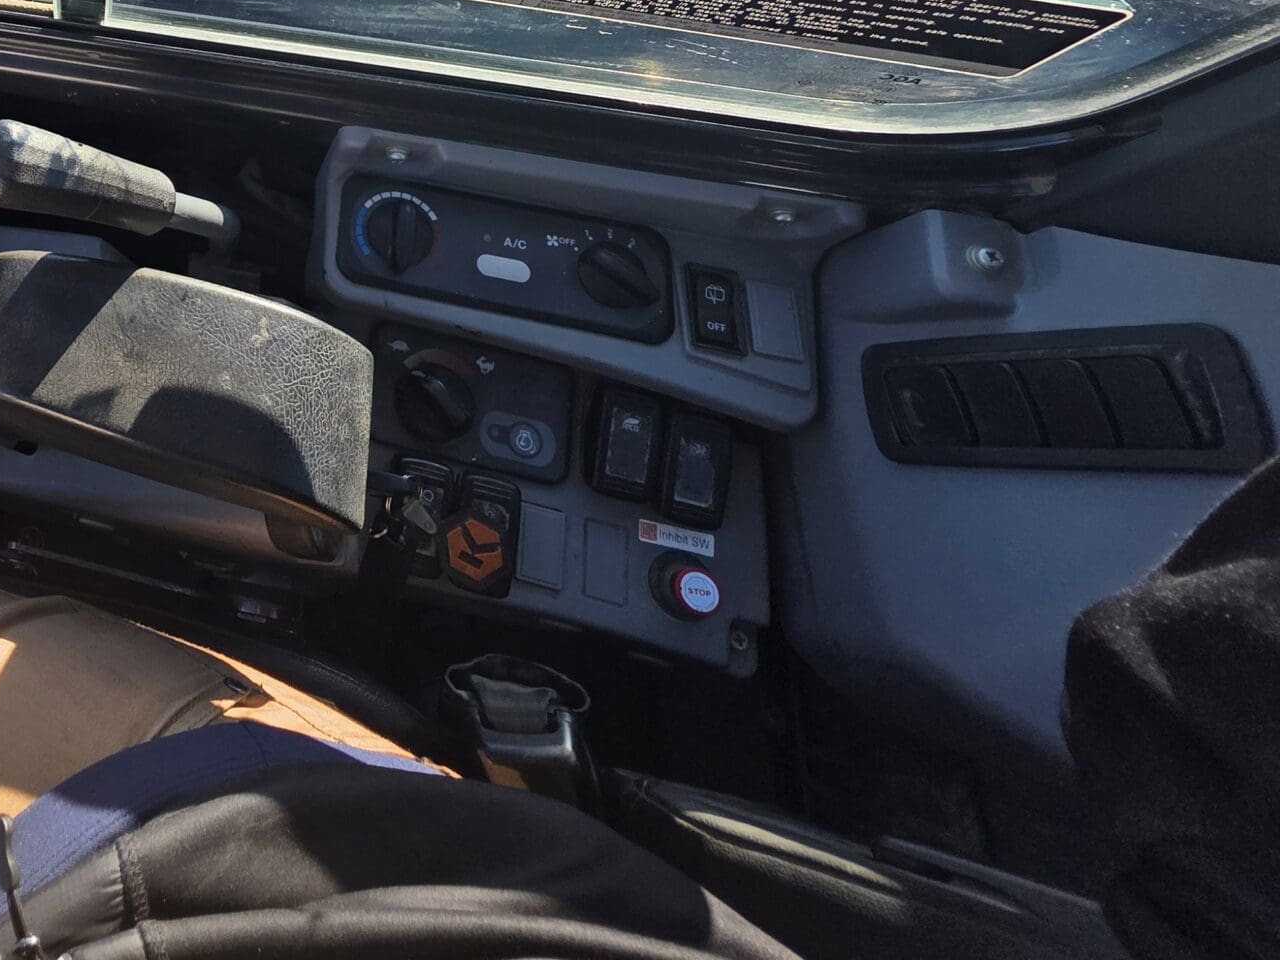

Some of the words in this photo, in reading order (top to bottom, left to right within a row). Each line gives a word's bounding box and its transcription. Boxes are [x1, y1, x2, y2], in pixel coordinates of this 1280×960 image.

[504, 237, 528, 250] A/C
[558, 236, 576, 246] OFF
[706, 321, 727, 332] OFF
[658, 528, 690, 545] Inhibit
[692, 536, 710, 550] SW
[688, 586, 712, 597] STOP
